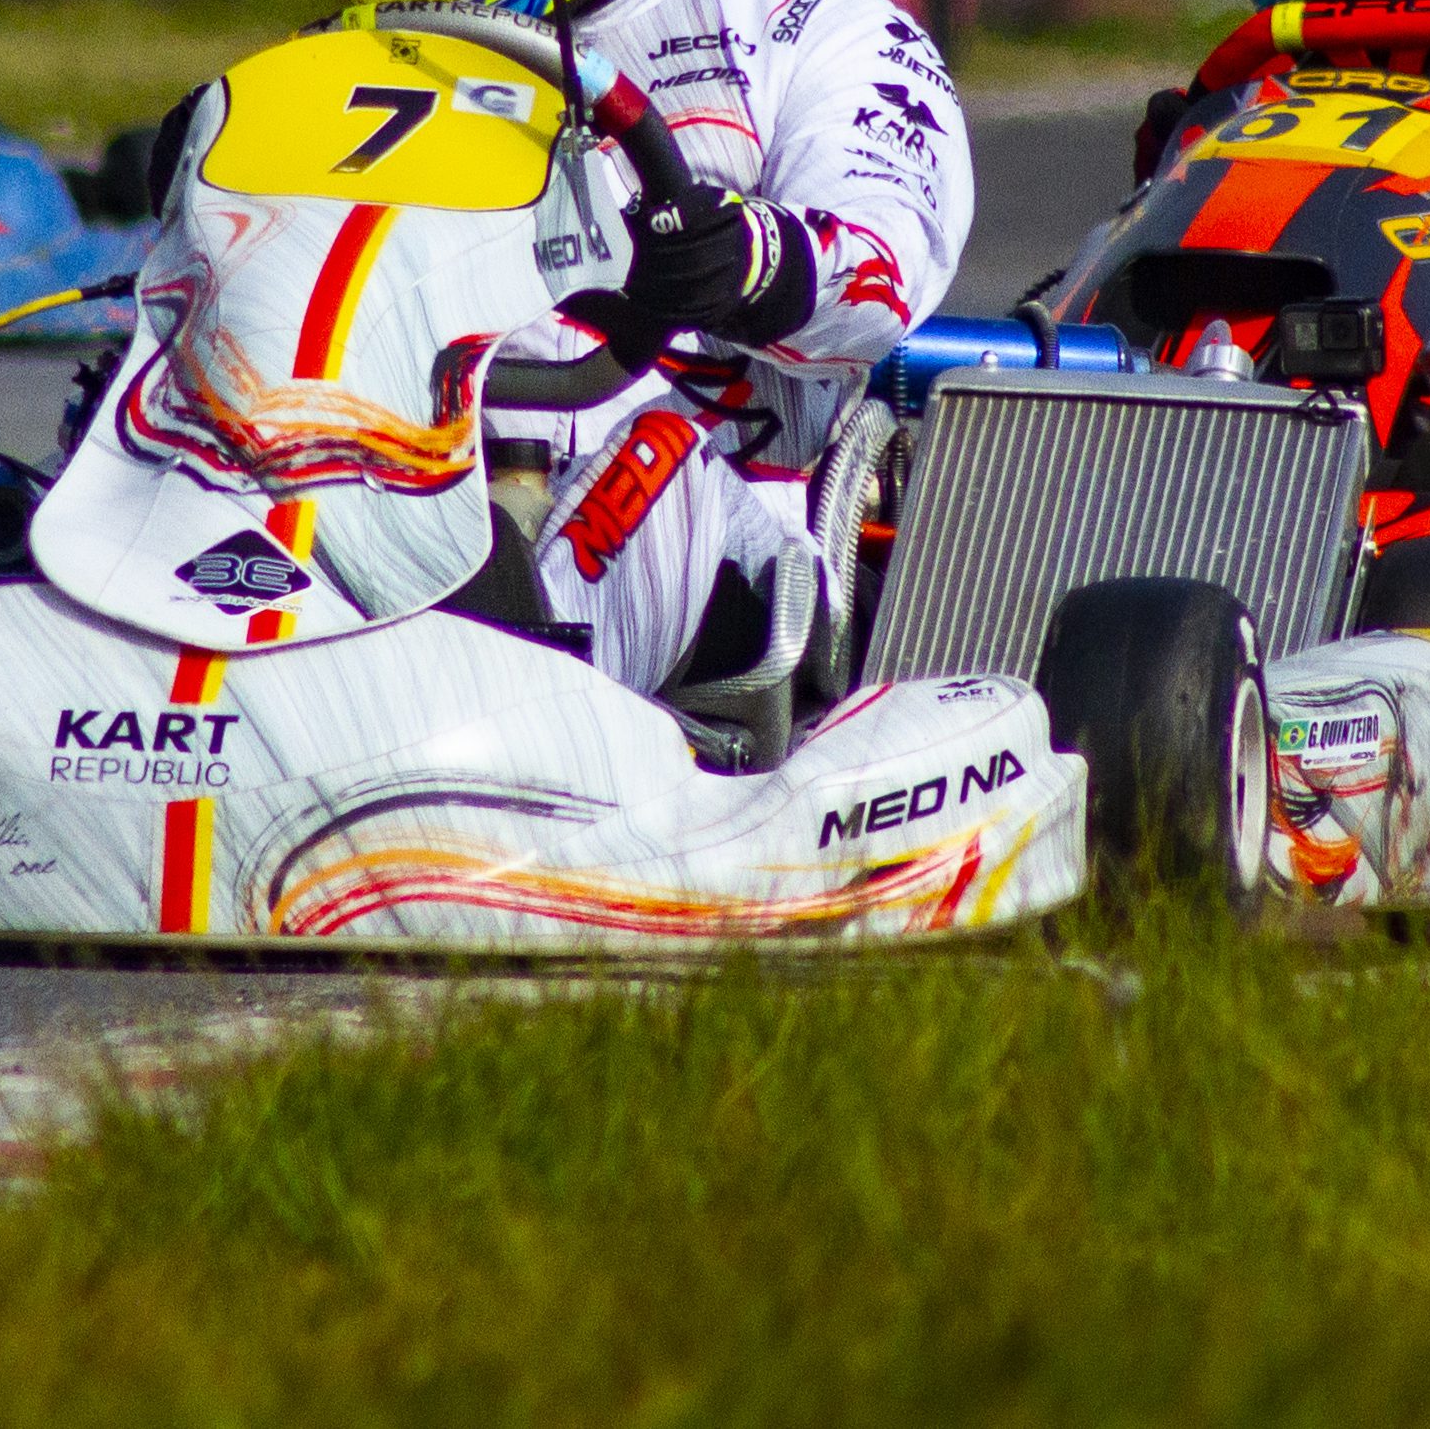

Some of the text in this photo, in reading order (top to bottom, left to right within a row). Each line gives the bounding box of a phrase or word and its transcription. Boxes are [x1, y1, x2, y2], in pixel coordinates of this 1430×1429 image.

[328, 86, 437, 173] 7
[1216, 98, 1413, 153] 61
[54, 709, 240, 755] KART
[49, 756, 231, 788] REPUBLIC
